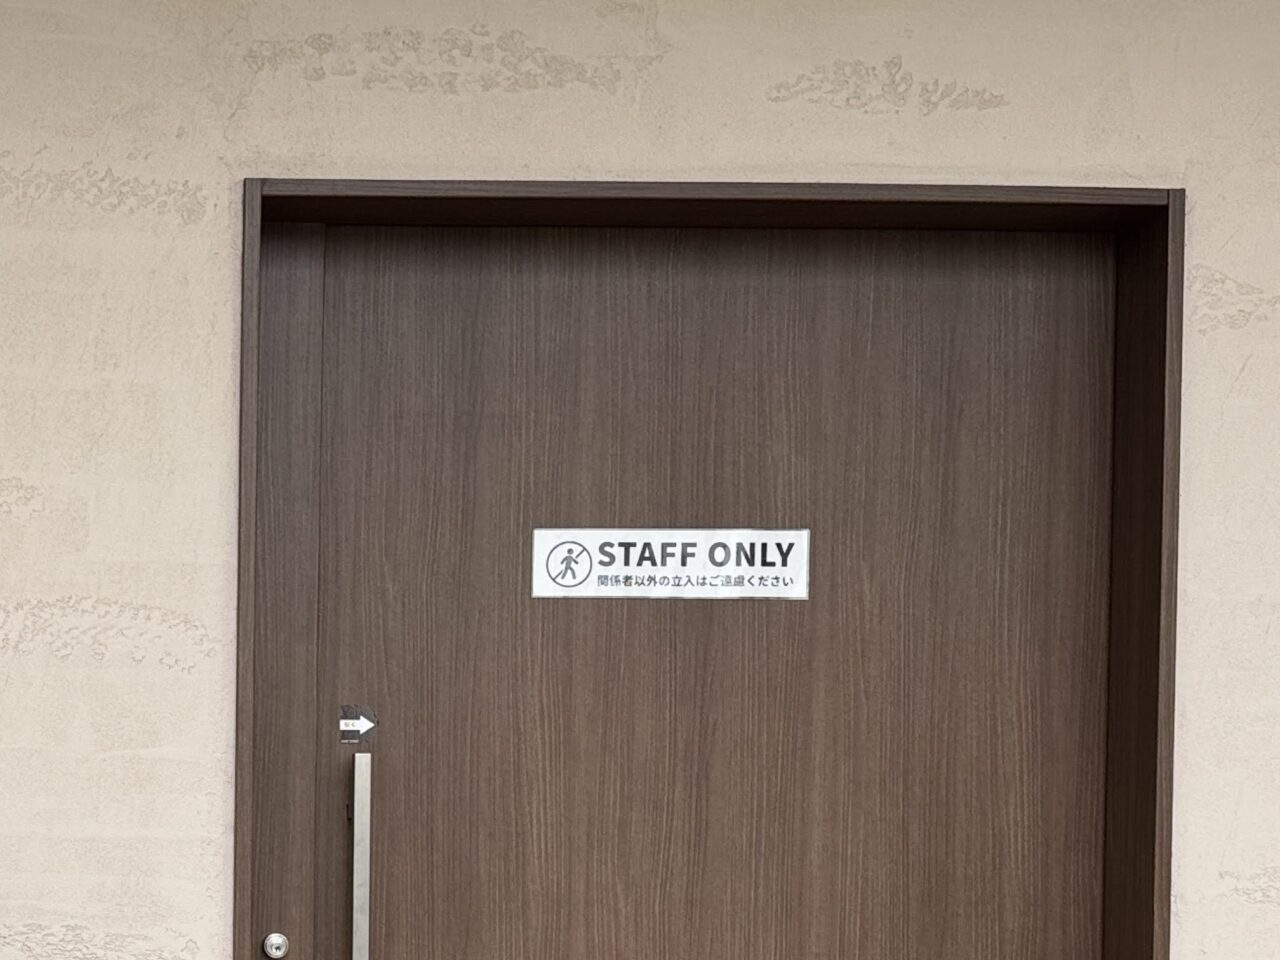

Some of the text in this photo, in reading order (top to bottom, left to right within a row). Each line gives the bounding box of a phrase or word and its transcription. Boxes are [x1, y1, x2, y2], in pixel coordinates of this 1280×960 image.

[597, 541, 796, 568] STAFF ONLY
[597, 574, 794, 588] 関係者以外の立入はご遠慮ください
